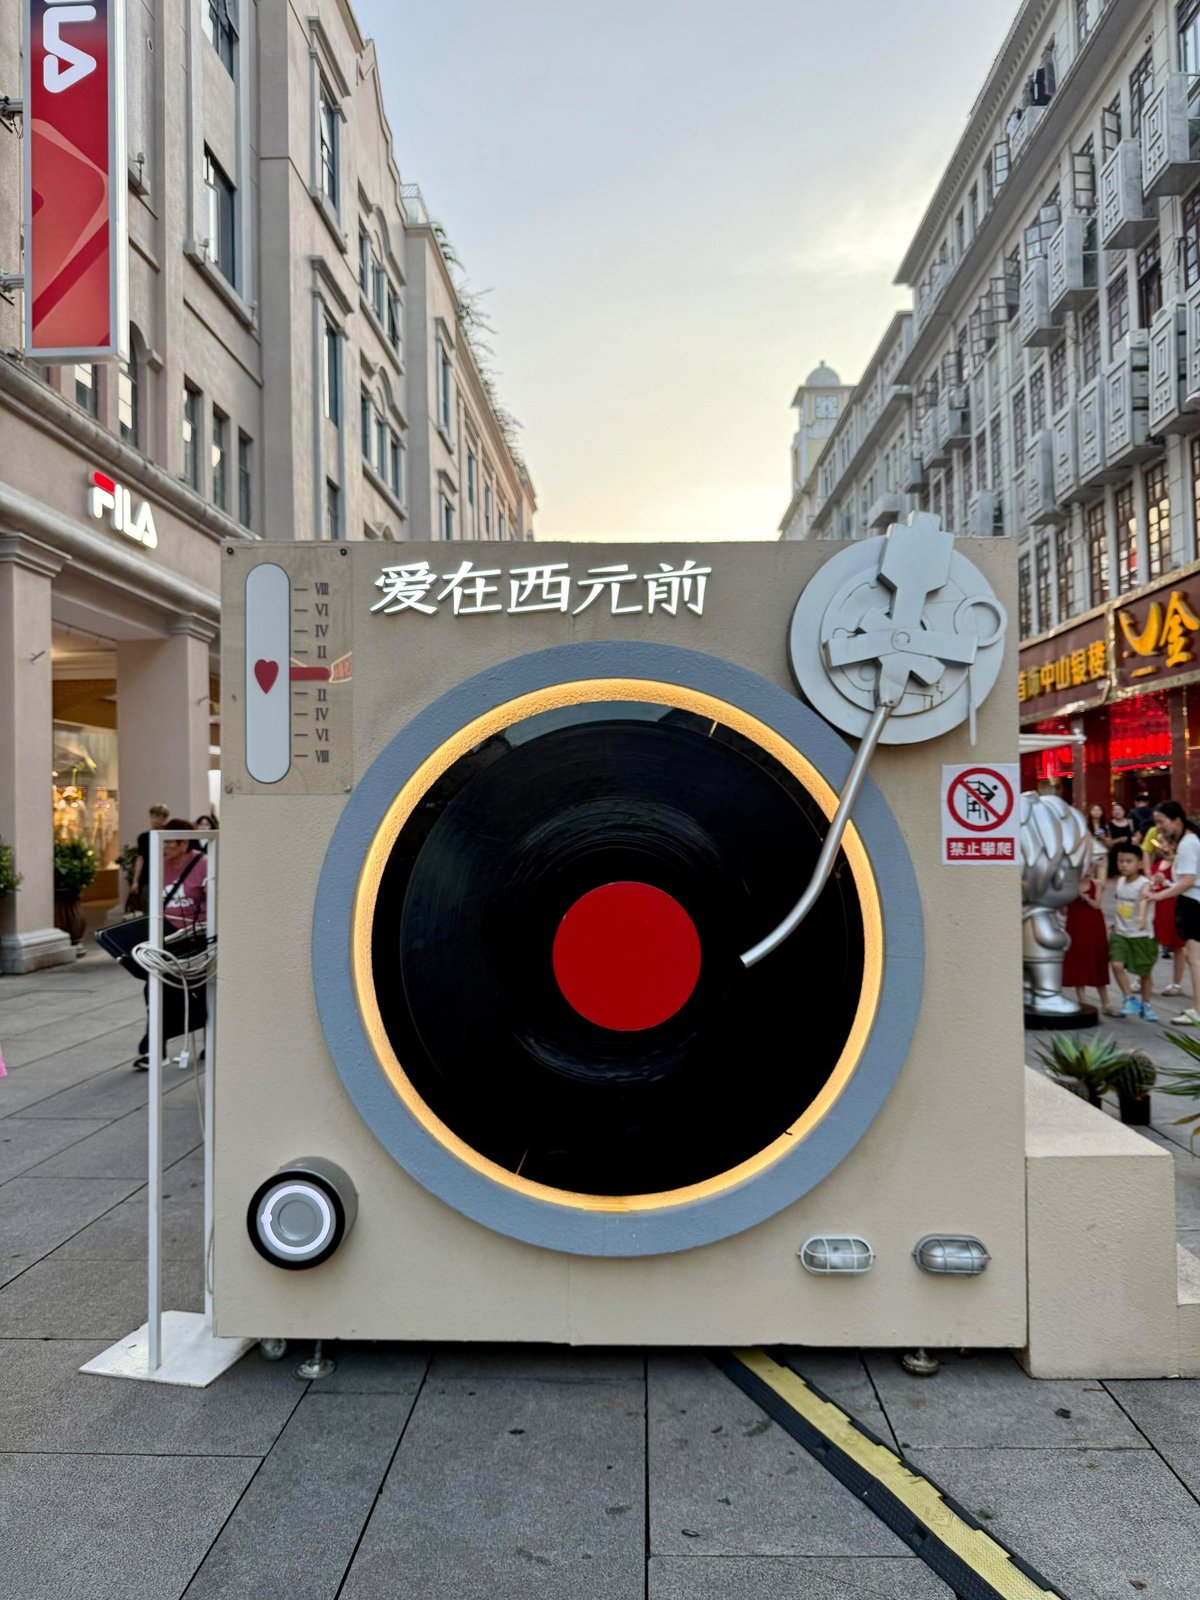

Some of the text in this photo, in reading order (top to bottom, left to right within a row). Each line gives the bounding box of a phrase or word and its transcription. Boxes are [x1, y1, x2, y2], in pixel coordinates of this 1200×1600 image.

[43, 0, 97, 93] LA
[91, 471, 158, 549] FILA
[369, 560, 712, 616] 爱在西元前
[315, 603, 329, 617] VI
[315, 624, 329, 638] IV
[315, 707, 329, 721] IV
[315, 728, 329, 742] VI
[949, 841, 1013, 857] 禁止攀爬
